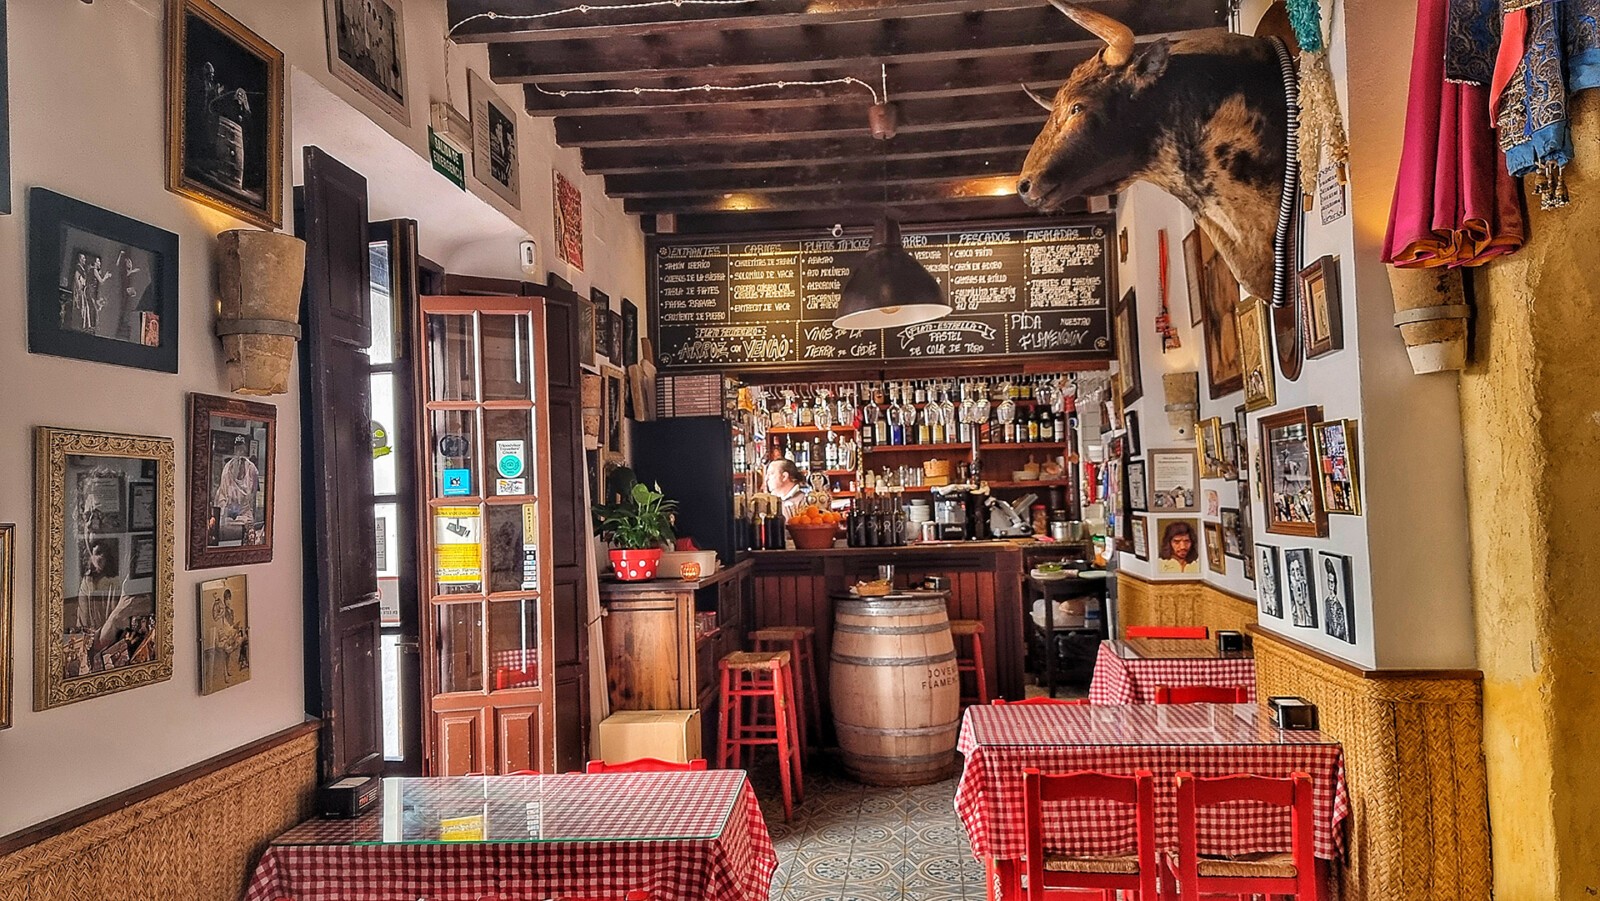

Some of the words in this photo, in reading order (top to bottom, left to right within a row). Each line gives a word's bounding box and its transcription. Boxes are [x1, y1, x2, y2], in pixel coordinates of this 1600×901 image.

[432, 149, 463, 181] EMERGENCIA
[959, 232, 1011, 244] PESCADOS
[1026, 228, 1079, 241] ENSALADAS
[671, 246, 721, 257] ENTRANTES
[744, 244, 781, 254] CARNES
[804, 240, 835, 253] PLATOS
[686, 273, 695, 282] DE
[696, 273, 704, 281] LA
[766, 270, 775, 279] DE
[777, 270, 795, 278] VACA
[686, 287, 694, 295] DE
[763, 304, 772, 312] DE
[774, 303, 791, 312] VACA
[696, 312, 705, 320] DE
[1011, 311, 1042, 330] PIDA
[1060, 317, 1091, 326] NUESTRO
[804, 325, 833, 341] VINOS
[909, 323, 933, 333] PLATO
[937, 321, 977, 331] ESTRELLA
[929, 331, 963, 343] PASTEL
[677, 340, 729, 360] ARROZ
[742, 338, 789, 358] VENAO
[803, 344, 836, 358] TIERRA
[909, 346, 922, 356] DE
[926, 343, 946, 355] COLA
[948, 343, 961, 353] DE
[964, 342, 985, 354] TORO
